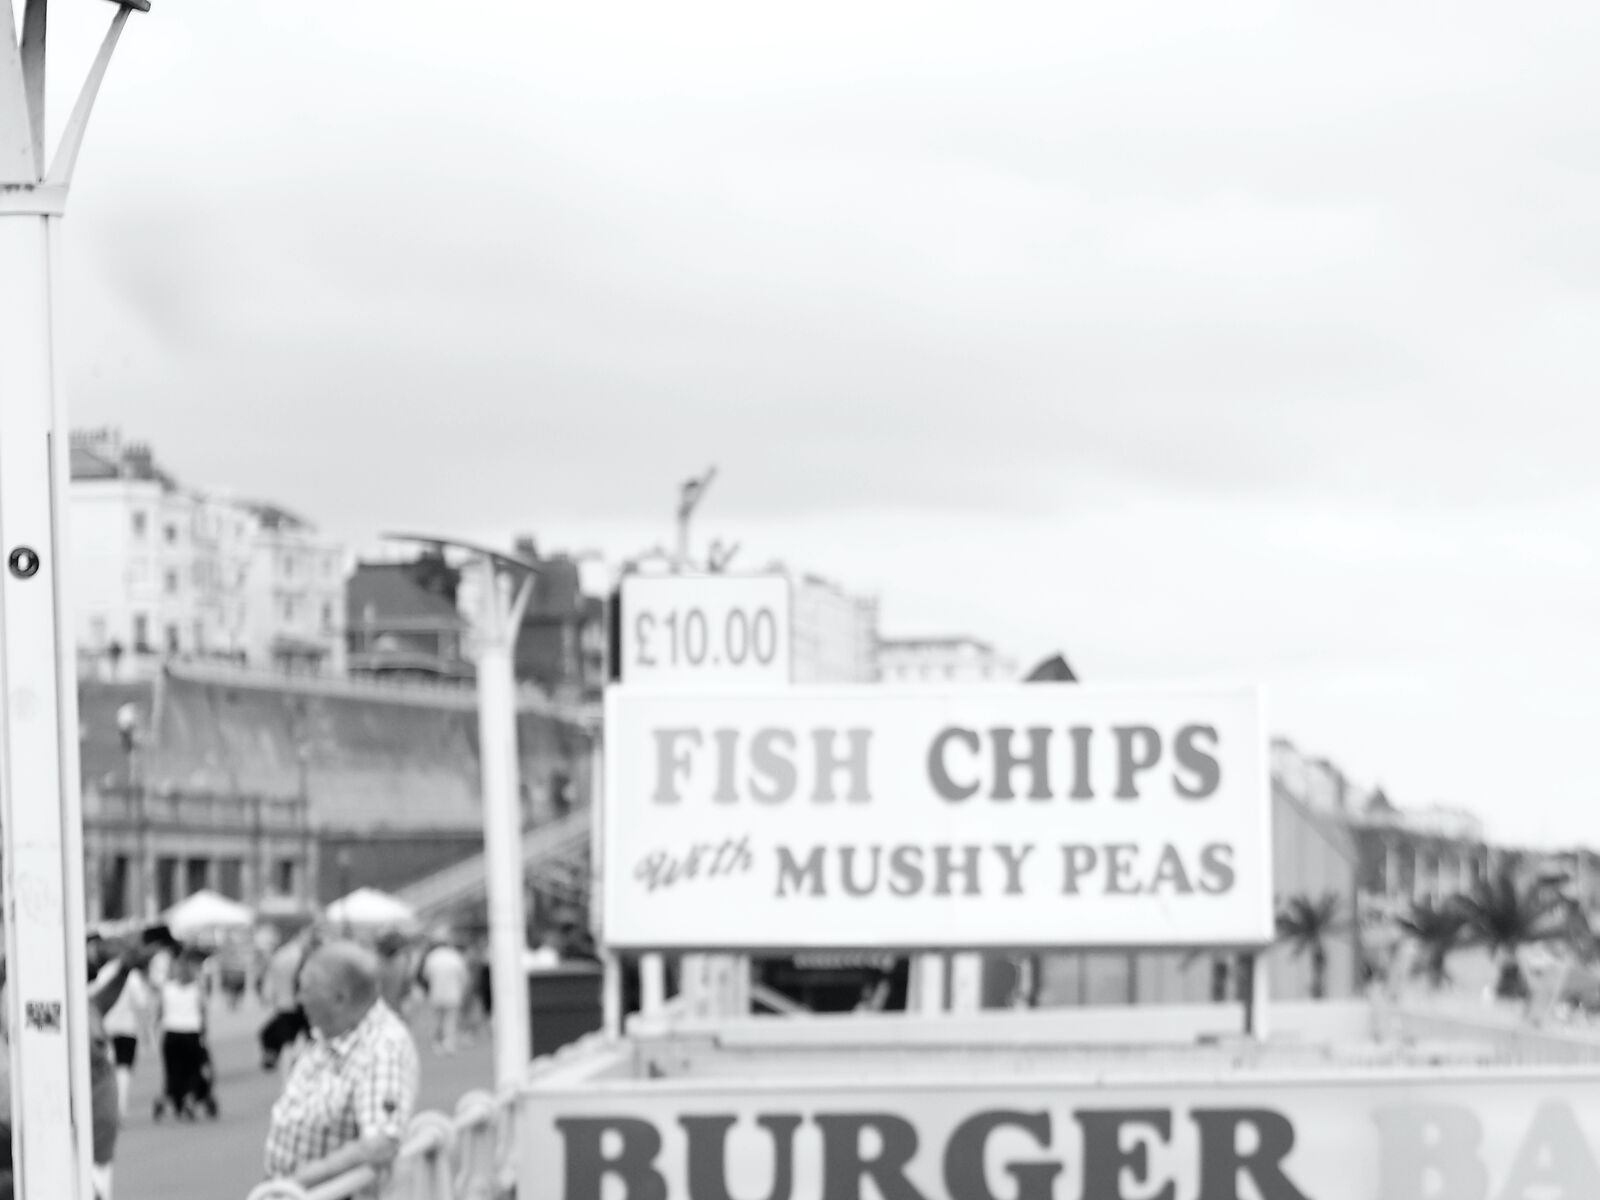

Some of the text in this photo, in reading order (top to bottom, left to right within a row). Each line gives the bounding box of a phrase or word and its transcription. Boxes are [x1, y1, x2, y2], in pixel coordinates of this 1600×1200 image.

[634, 606, 778, 668] £10.00
[651, 723, 1222, 806] FISH CHIPS
[774, 842, 1036, 899] MUSHY
[1060, 841, 1237, 897] PEAS
